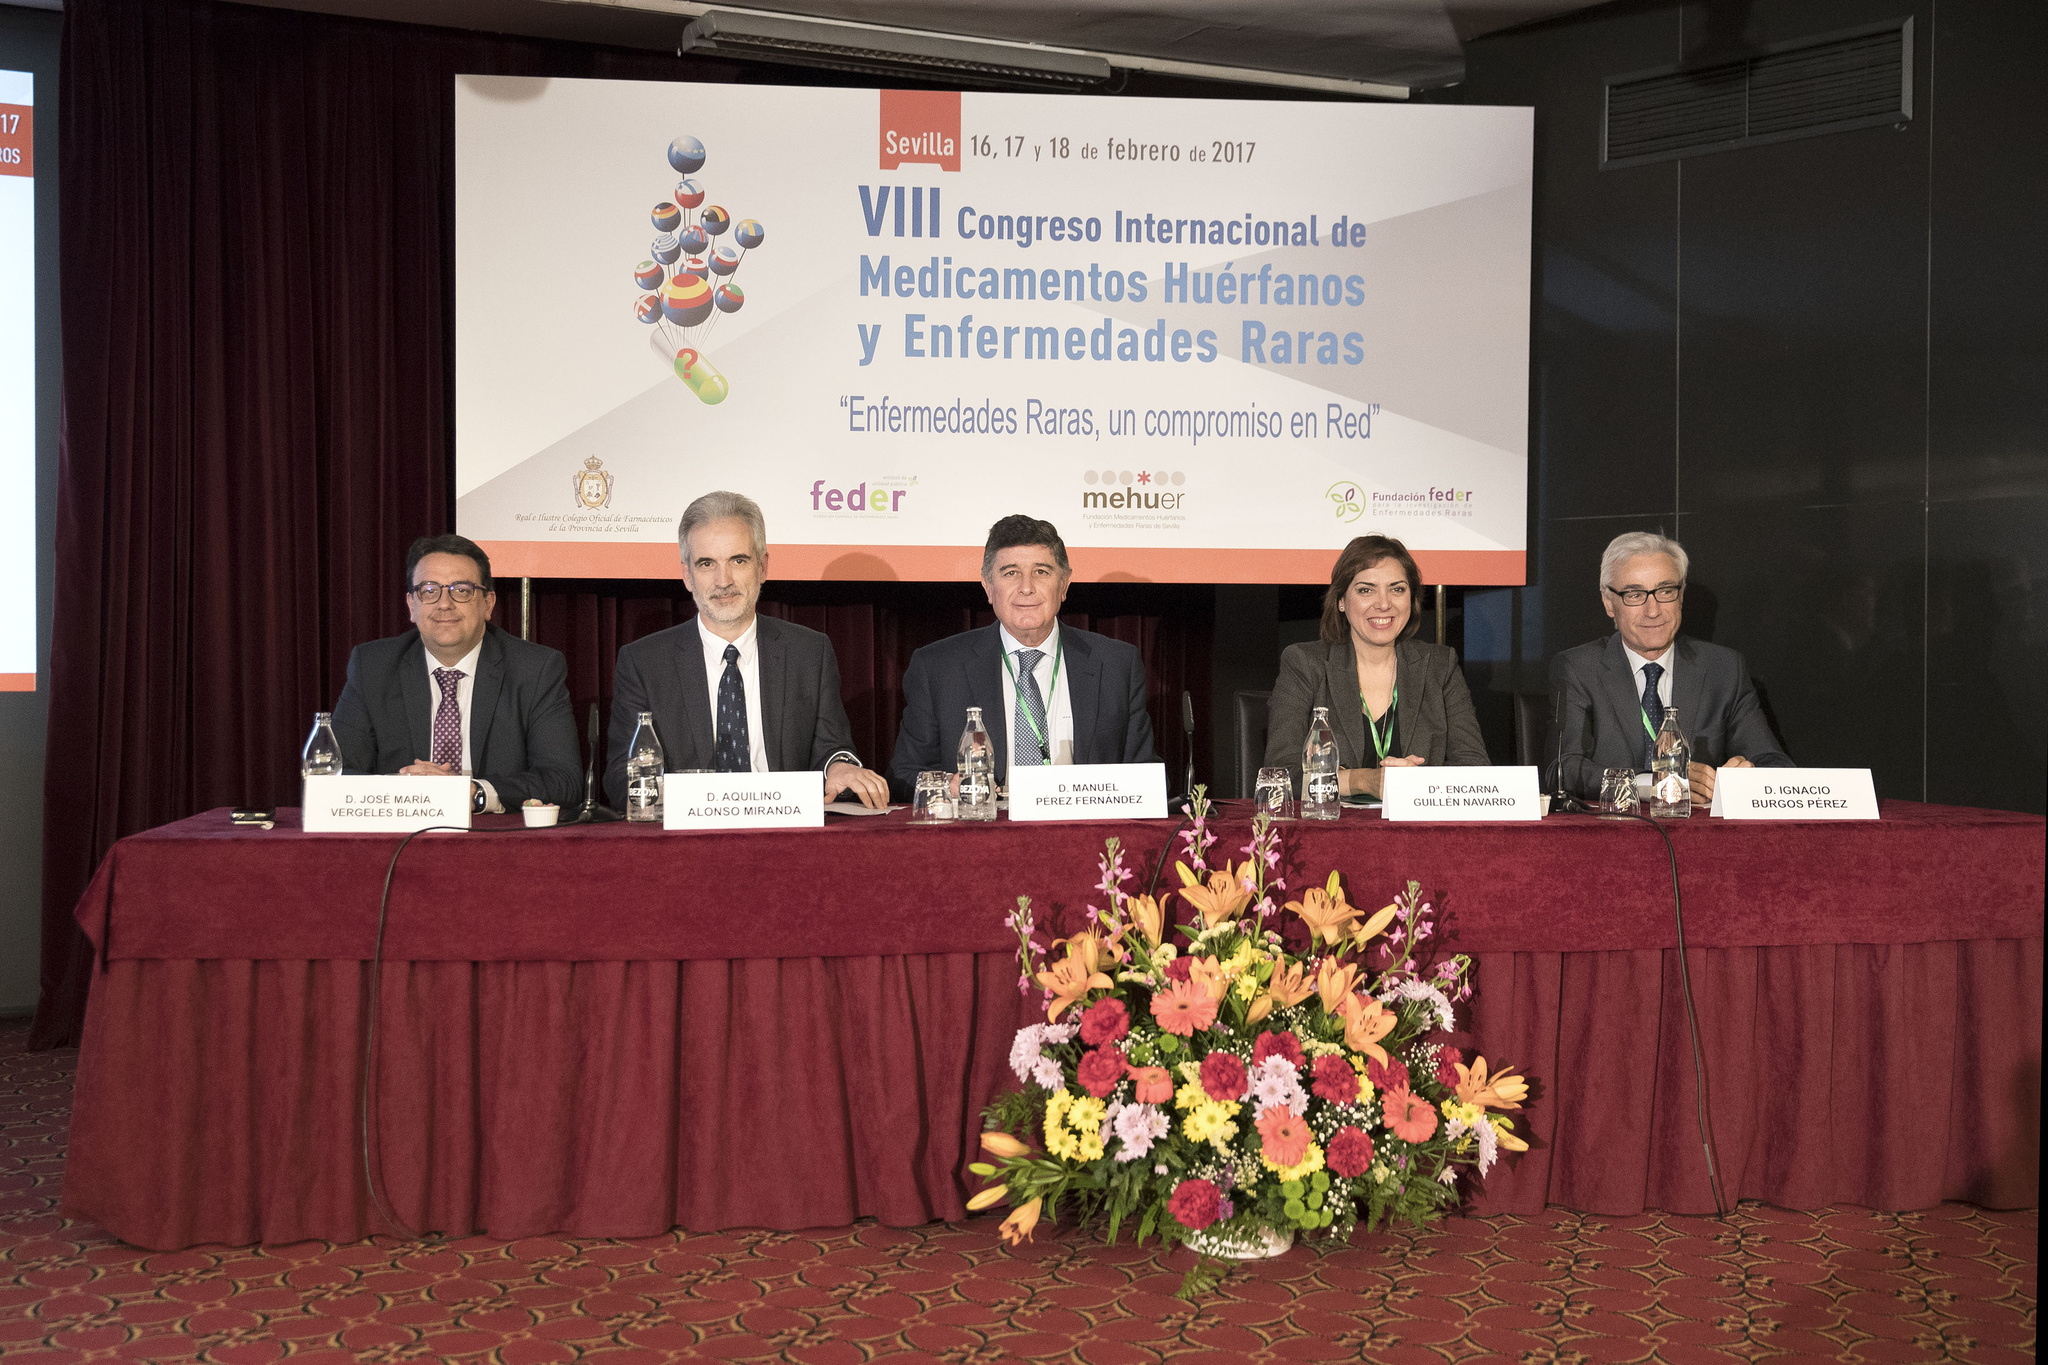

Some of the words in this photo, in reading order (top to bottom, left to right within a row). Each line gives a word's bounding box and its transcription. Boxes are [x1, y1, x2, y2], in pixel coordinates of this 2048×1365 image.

[885, 131, 955, 157] Sevilla
[970, 134, 998, 160] 16,
[1004, 135, 1025, 158] 17
[1034, 145, 1041, 163] y
[1049, 136, 1070, 159] 18
[1081, 142, 1098, 160] de
[1107, 137, 1181, 162] febrero
[1189, 145, 1206, 163] de
[1211, 140, 1256, 164] 2017
[858, 185, 940, 238] VIII
[958, 206, 1101, 248] Congreso
[1116, 211, 1319, 247] Internacional
[1332, 215, 1366, 248] de
[860, 255, 1147, 302] Medicamentos
[1165, 261, 1366, 307] Huérfanos
[858, 324, 882, 367] y
[905, 314, 1217, 363] Enfermedades
[1242, 319, 1365, 366] Raras
[841, 395, 1017, 434] “Enfermedades
[1027, 399, 1099, 441] Raras,
[1110, 411, 1136, 437] un
[1145, 402, 1282, 446] compromiso
[1291, 413, 1318, 439] en
[1326, 402, 1382, 440] Red”
[810, 480, 907, 512] feder
[1083, 487, 1185, 509] mehuer
[1373, 492, 1426, 502] Fundación
[1428, 486, 1473, 502] feder
[1372, 508, 1443, 517] Enfermedades
[1444, 508, 1473, 517] Raras
[515, 513, 532, 522] Real
[538, 513, 561, 522] Ilustre
[562, 513, 587, 524] Colegio
[588, 514, 613, 525] Oficial
[613, 514, 622, 523] de
[623, 515, 673, 523] Farmacéuticos
[549, 523, 558, 531] de
[559, 523, 567, 531] la
[568, 523, 603, 532] Provincia
[604, 523, 613, 532] de
[614, 523, 640, 533] Sevilla
[1058, 783, 1070, 793] D.
[1072, 783, 1119, 792] MANUEL
[1309, 784, 1339, 794] BEZOYA
[1445, 785, 1500, 794] ENCARNA
[1764, 785, 1777, 795] D.
[1779, 785, 1831, 795] IGNACIO
[345, 794, 357, 804] D.
[359, 792, 391, 804] JOSÉ
[394, 792, 431, 804] MARÍA
[706, 792, 719, 802] D.
[721, 791, 782, 802] AQUILINO
[1035, 795, 1073, 806] PÉREZ
[1075, 794, 1143, 806] FERNÁNDEZ
[1413, 795, 1460, 807] GUILLÉN
[1463, 797, 1516, 807] NAVARRO
[1751, 799, 1804, 809] BURGOS
[1807, 797, 1848, 809] PÉREZ
[330, 807, 393, 818] VERGELES
[396, 808, 445, 818] BLANCA
[687, 806, 740, 817] ALONSO
[743, 805, 802, 816] MIRANDA
